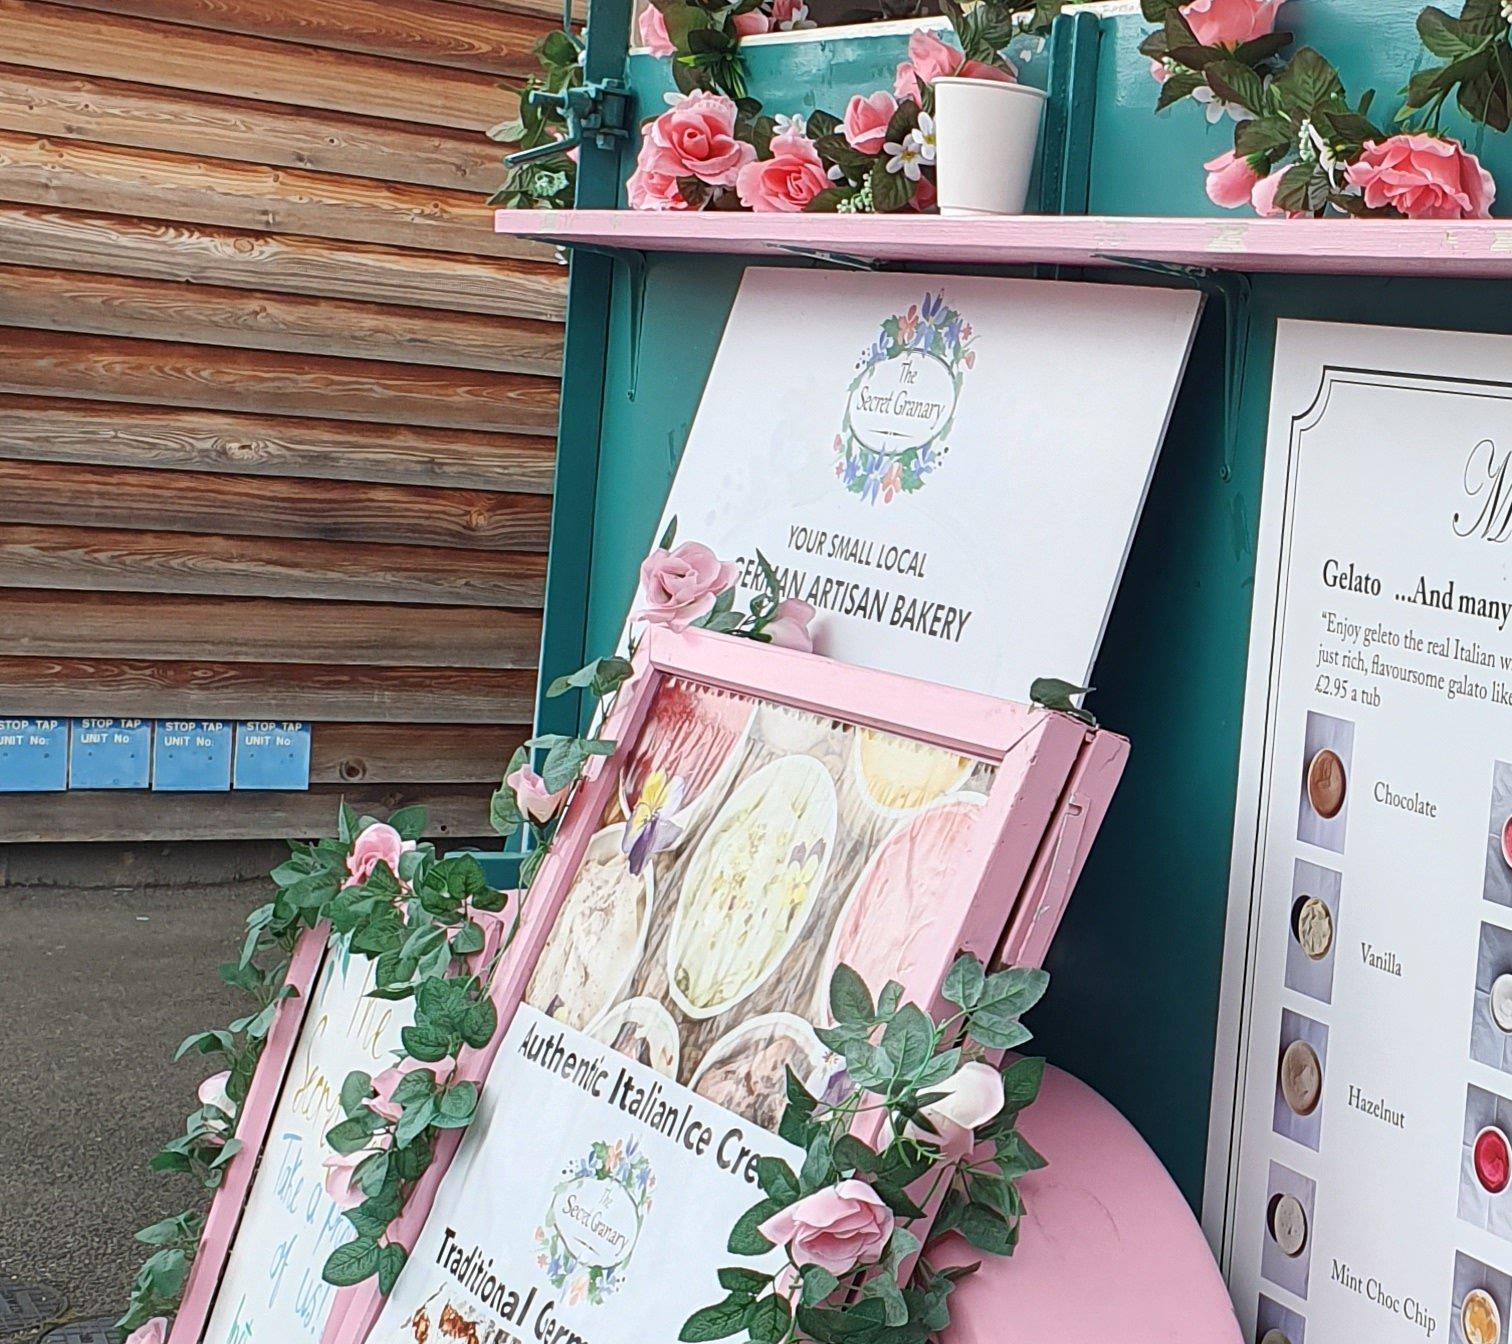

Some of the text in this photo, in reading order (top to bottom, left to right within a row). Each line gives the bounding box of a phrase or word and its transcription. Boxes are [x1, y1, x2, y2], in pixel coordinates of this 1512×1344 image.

[898, 360, 918, 385] The
[855, 384, 946, 430] Secret Granary
[788, 524, 928, 579] YOUR SMALL LOCAL
[806, 574, 889, 624] ARTISAN
[889, 594, 972, 643] BAKERY
[1322, 558, 1382, 597] Gelato
[1458, 593, 1512, 632] many
[1363, 622, 1400, 653] geleto
[1403, 631, 1424, 653] the
[1426, 636, 1450, 658] real
[1453, 639, 1496, 669] Italian
[1314, 676, 1382, 708] £2.95 a tub
[1316, 644, 1339, 669] just
[1340, 649, 1369, 677] rich,
[1370, 653, 1445, 692] flavoursome
[1447, 669, 1488, 701] galato
[0, 720, 58, 730] STOP TAP
[80, 733, 108, 744] UNIT
[82, 718, 142, 729] STOP TAP
[164, 736, 191, 747] UNIT
[165, 721, 223, 732] STOP TAP
[245, 736, 271, 746] UNIT
[247, 721, 303, 732] STOP TAP
[1373, 781, 1438, 819] Chocolate
[1360, 943, 1402, 977] Vanilla
[518, 1021, 764, 1190] Authentic Italian Ice Cre
[1347, 1085, 1406, 1130] Hazelnut
[562, 1194, 629, 1251] Secret Granary
[435, 1227, 538, 1327] Traditional
[1330, 1258, 1437, 1338] Mint Choc Chip
